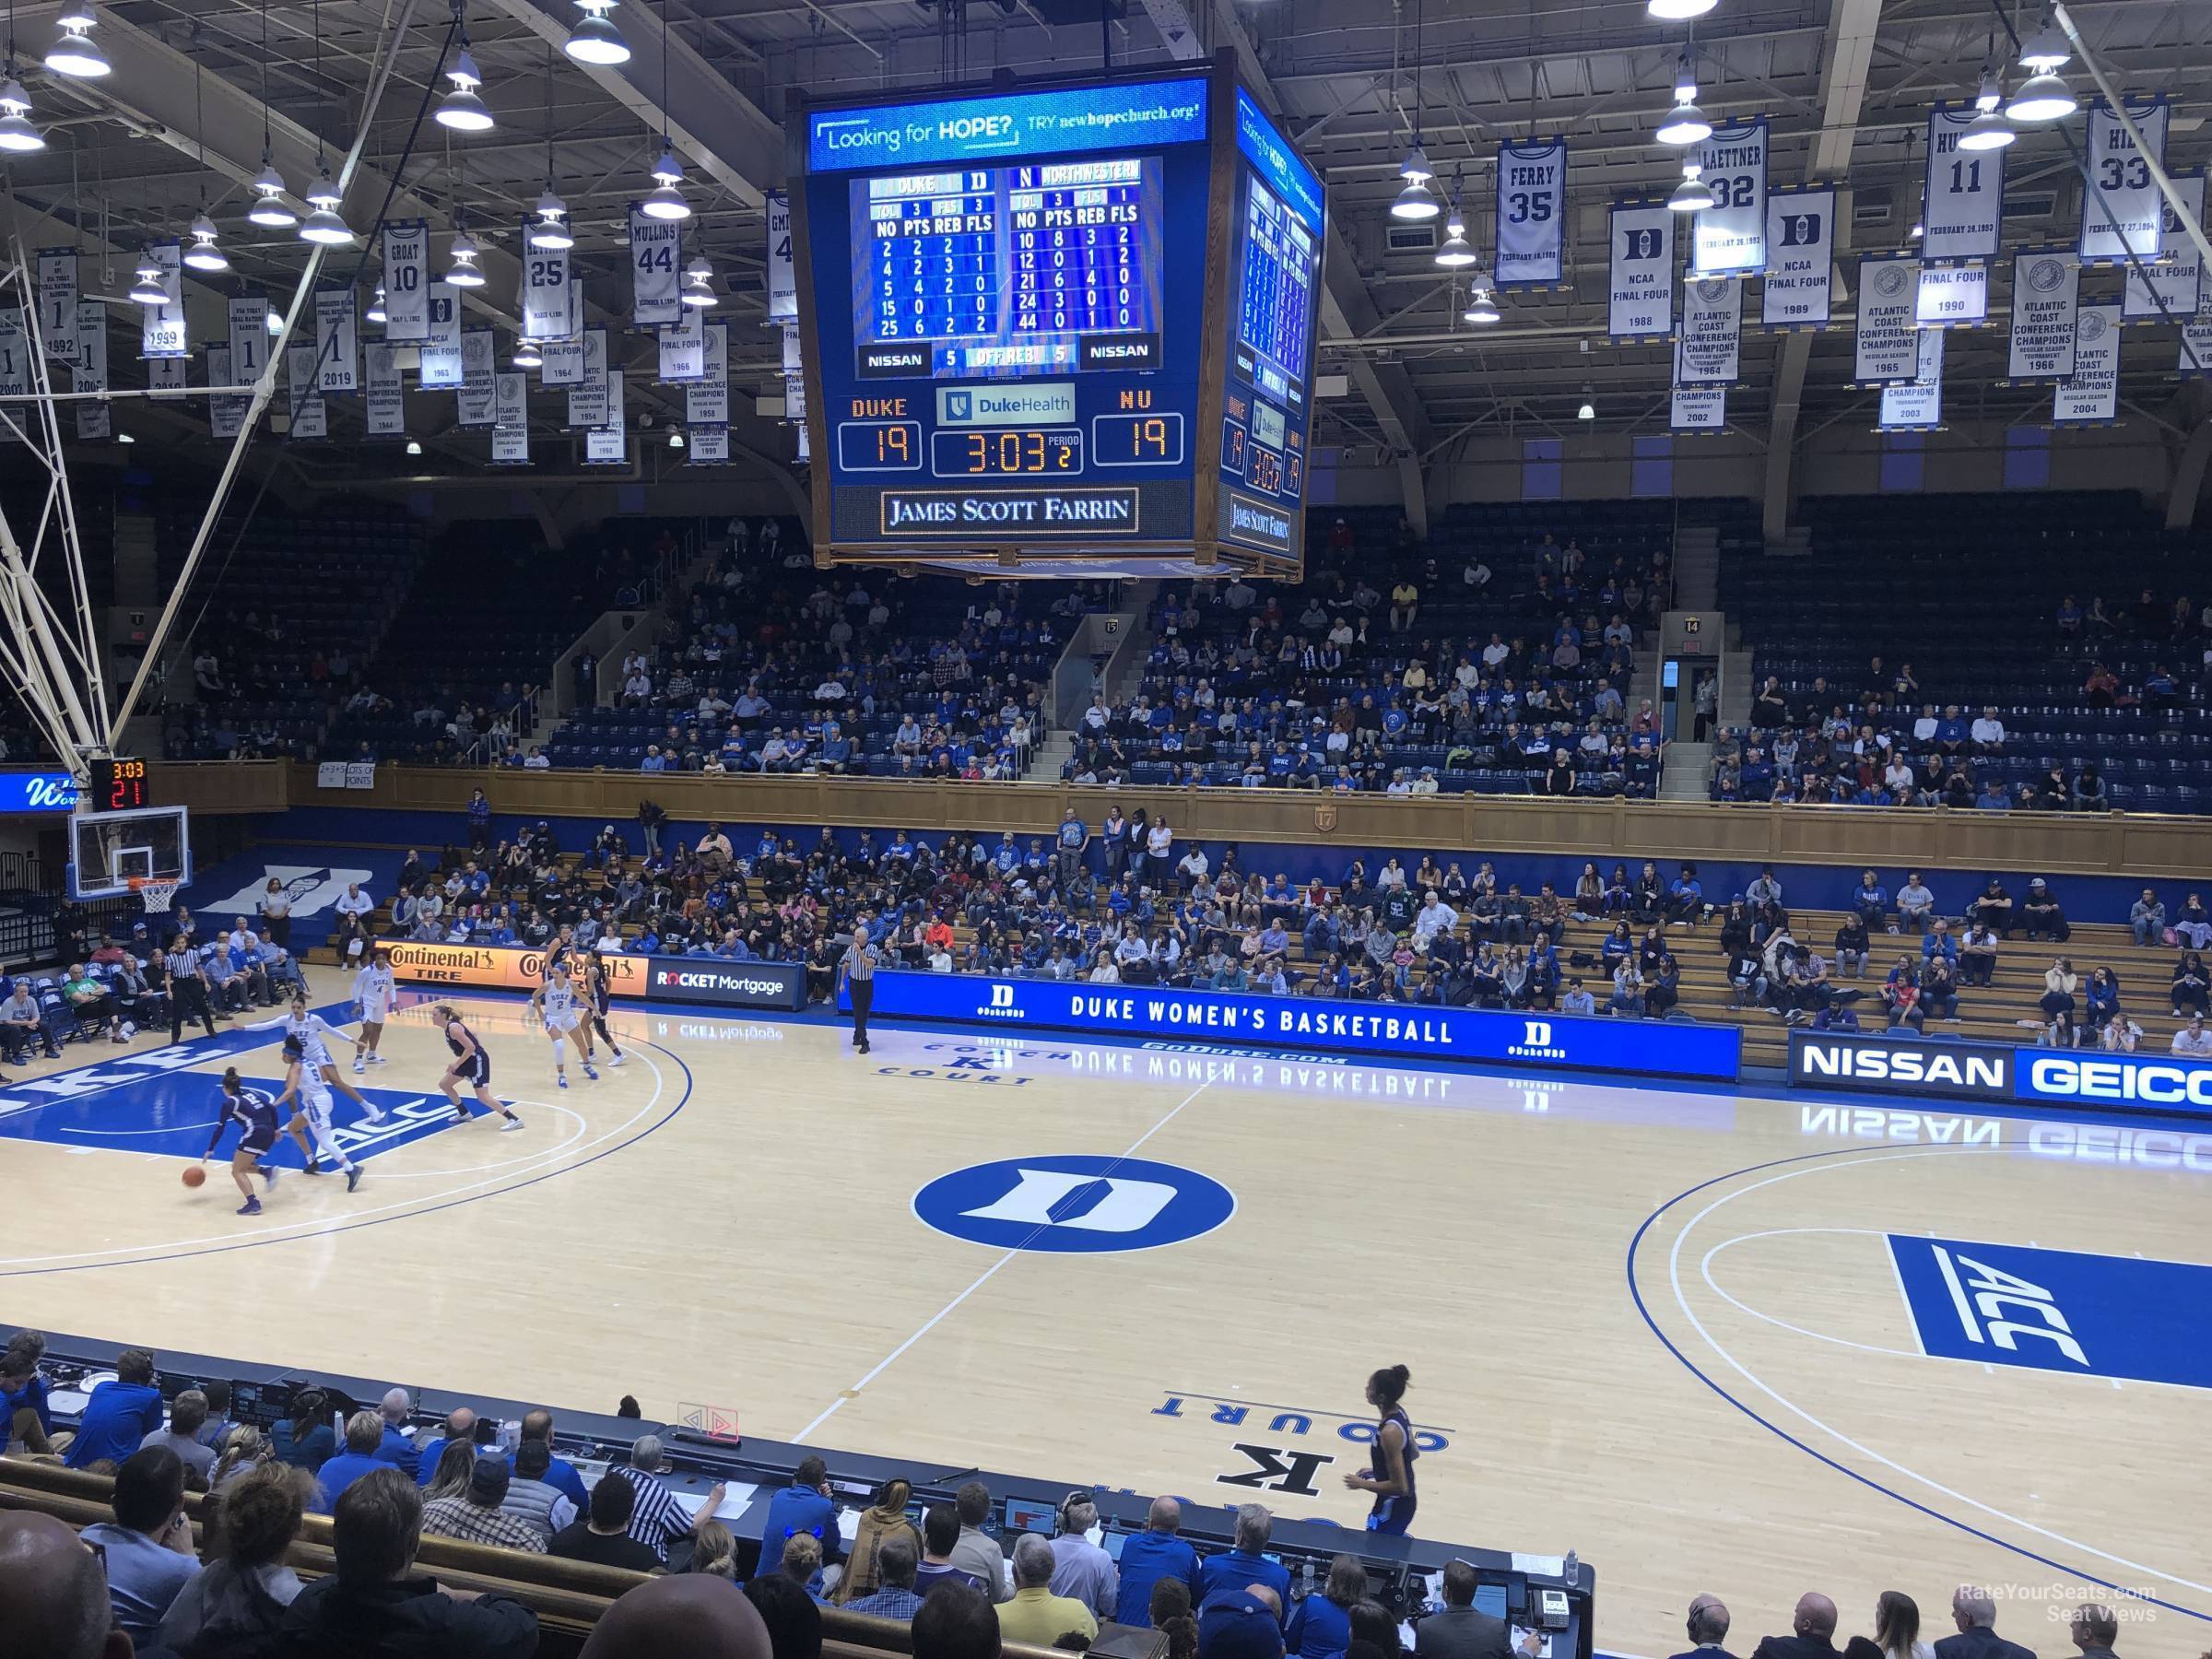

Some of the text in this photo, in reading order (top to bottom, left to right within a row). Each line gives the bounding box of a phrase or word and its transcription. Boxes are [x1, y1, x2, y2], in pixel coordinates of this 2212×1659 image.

[1029, 115, 1057, 131] TRY
[830, 114, 1013, 152] Looking for HOPE?
[1703, 146, 1760, 171] LAETTNER
[1042, 161, 1140, 185] NORTHWESTERN
[1511, 166, 1555, 187] FERRY
[1949, 159, 1981, 193] 11
[2100, 157, 2149, 191] 33
[900, 176, 935, 194] DUKE
[1054, 193, 1063, 206] 3
[1710, 175, 1754, 210] 32
[913, 199, 983, 216] 3 3
[1509, 191, 1552, 223] 35
[1017, 205, 1138, 229] NO PTS REB FLS
[634, 224, 676, 241] MULLINS
[877, 215, 993, 238] NO PTS REB FLS
[1930, 226, 1965, 235] FEBRUARY
[1019, 227, 1129, 249] 10 8 3 2
[392, 244, 418, 261] GROAT
[883, 238, 953, 257] 2 2 2
[638, 247, 672, 274] 44
[883, 257, 954, 276] 4 2 3
[1784, 261, 1811, 272] NCAA
[394, 265, 418, 292] 10
[531, 260, 562, 288] 25
[1923, 272, 1984, 284] FINAL FOUR
[2166, 266, 2195, 277] FOUR
[1629, 274, 1654, 285] NCAA
[1768, 276, 1827, 289] FINAL FOUR
[1613, 289, 1669, 302] FINAL FOUR
[1784, 304, 1809, 315] 1989
[1868, 305, 1910, 317] ATLANTIC
[1938, 300, 1965, 312] 1990
[2024, 300, 2067, 312] ATLANTIC
[53, 301, 64, 329] 1
[1630, 317, 1653, 327] 1988
[1693, 312, 1732, 322] ATLANTIC
[2030, 312, 2060, 323] COAST
[1699, 323, 1725, 332] COAST
[1874, 317, 1902, 328] COAST
[2014, 323, 2075, 335] CONFERENCE
[1685, 332, 1738, 343] CONFERENCE
[1859, 329, 1917, 340] CONFERENCE
[2016, 335, 2072, 347] CHAMPIONS
[48, 339, 74, 353] 1992
[661, 339, 700, 350] FINAL FOUR
[1687, 343, 1735, 353] CHAMPIONS
[1861, 338, 1913, 350] CHAMPIONS
[83, 344, 95, 371] 1
[243, 341, 256, 369] 1
[441, 347, 460, 356] FOUR
[563, 347, 582, 356] FOUR
[947, 350, 956, 366] 5
[1090, 345, 1148, 359] NISSAN
[868, 355, 923, 367] NISSAN
[1875, 363, 1899, 373] 1965
[2030, 360, 2054, 371] 1966
[554, 370, 571, 378] 1964
[1699, 367, 1721, 376] 1964
[324, 372, 351, 386] 2019
[1888, 388, 1936, 398] CHAMPIONS
[2060, 381, 2112, 392] CHAMPIONS
[690, 391, 724, 399] CHAMPIONS
[1120, 390, 1151, 409] NU
[1676, 392, 1722, 402] CHAMPIONS
[853, 398, 908, 418] DUKE
[980, 395, 1070, 415] DukeHealth
[2073, 405, 2097, 414] 2004
[1688, 414, 1709, 422] 2002
[1900, 409, 1921, 418] 2003
[878, 428, 907, 462] 19
[1048, 436, 1079, 446] PERIOD
[1134, 420, 1166, 456] 19
[969, 432, 1045, 473] 3:03
[1059, 446, 1071, 468] 2
[890, 498, 1129, 526] JAMES SCOTT FARRIN
[1107, 622, 1117, 632] 15
[1688, 622, 1698, 633] 14
[113, 762, 144, 779] 3:03
[112, 781, 142, 808] 21
[1318, 813, 1333, 827] 17
[387, 944, 479, 969] Continental
[414, 969, 463, 982] TIRE
[657, 971, 784, 995] ROCKET Mortgage
[557, 1001, 564, 1010] 2
[1072, 996, 1453, 1043] DUKE WOMEN'S BASKETBALL
[1508, 1046, 1566, 1059] @DukeWBB
[1803, 1045, 2004, 1088] NISSAN
[878, 1067, 1035, 1085] COURT
[1956, 1254, 2090, 1367] ACC
[1149, 1396, 1450, 1452] COURT
[1213, 1442, 1336, 1497] K
